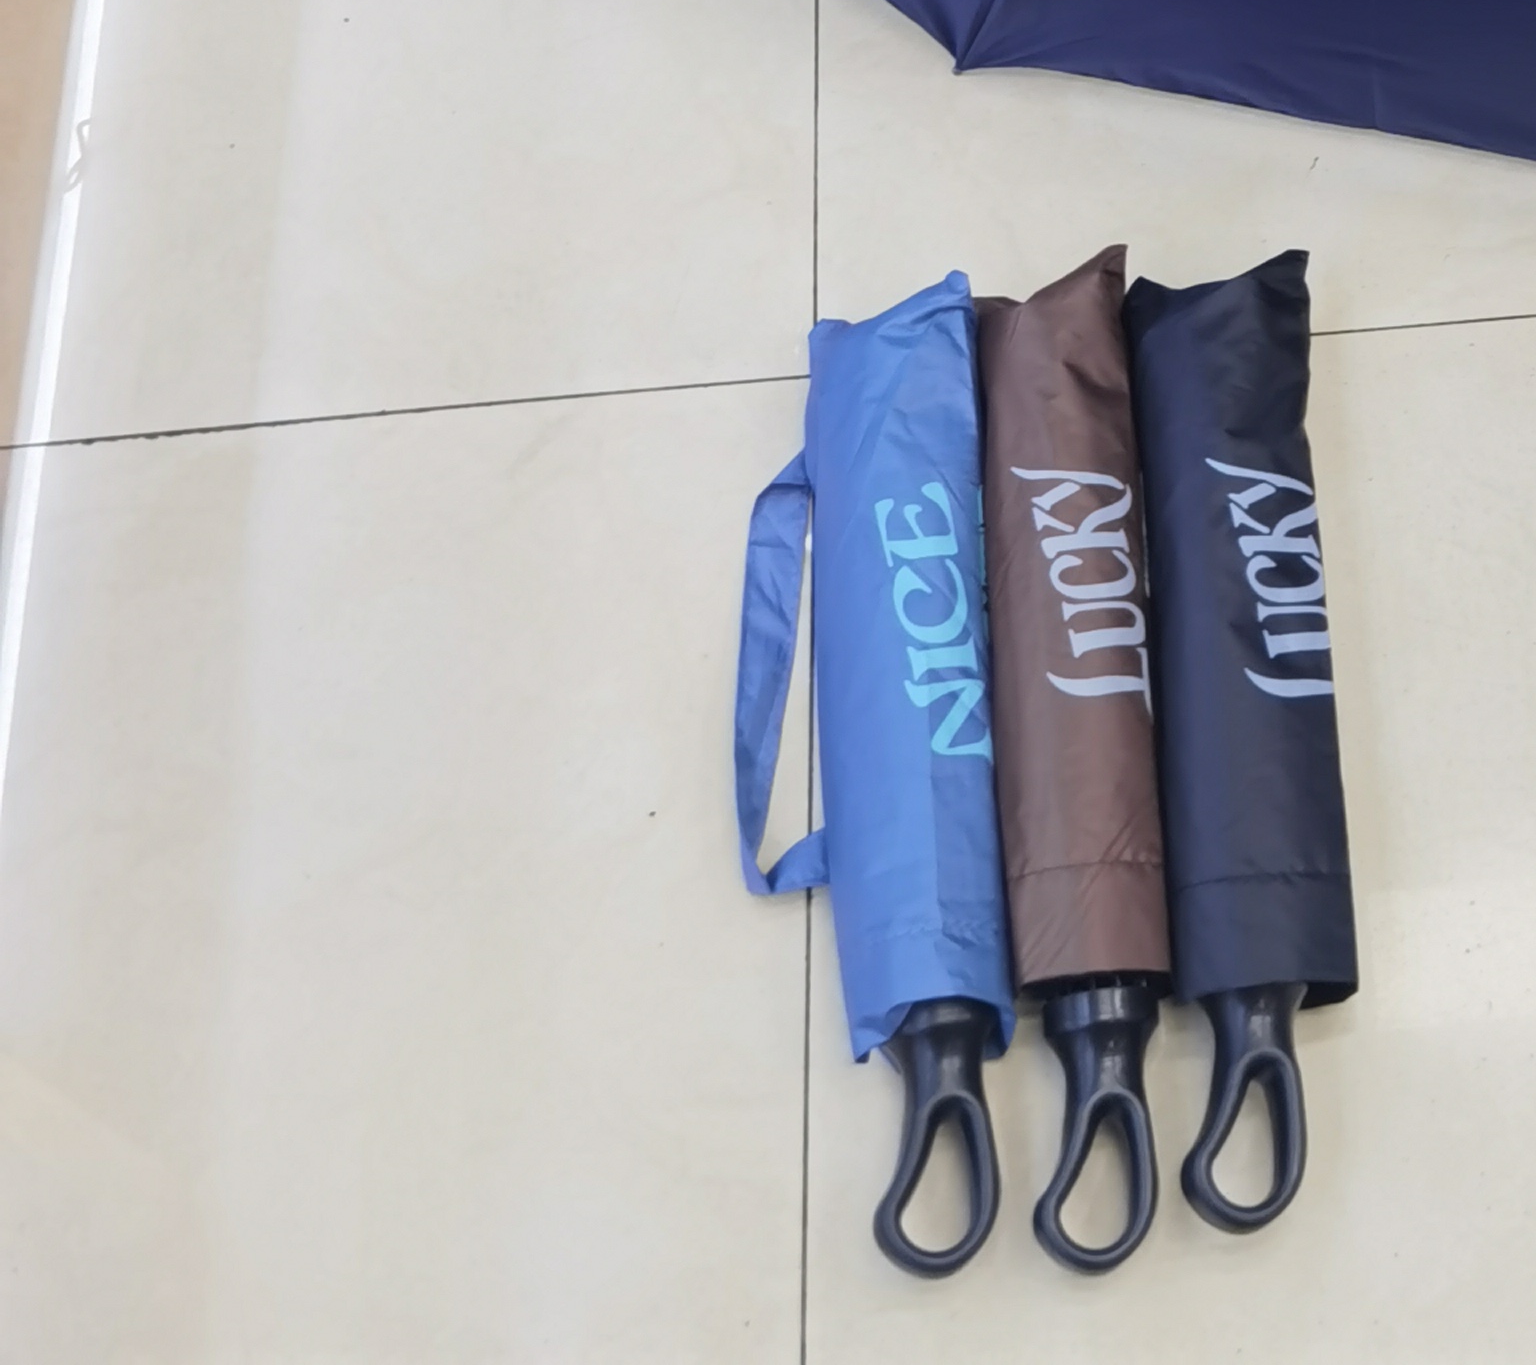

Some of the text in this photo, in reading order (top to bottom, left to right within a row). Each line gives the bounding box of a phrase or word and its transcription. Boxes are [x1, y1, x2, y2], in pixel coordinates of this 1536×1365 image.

[874, 481, 994, 765] NICE
[1010, 465, 1153, 718] LUCKY
[1204, 457, 1335, 698] LUCKY
